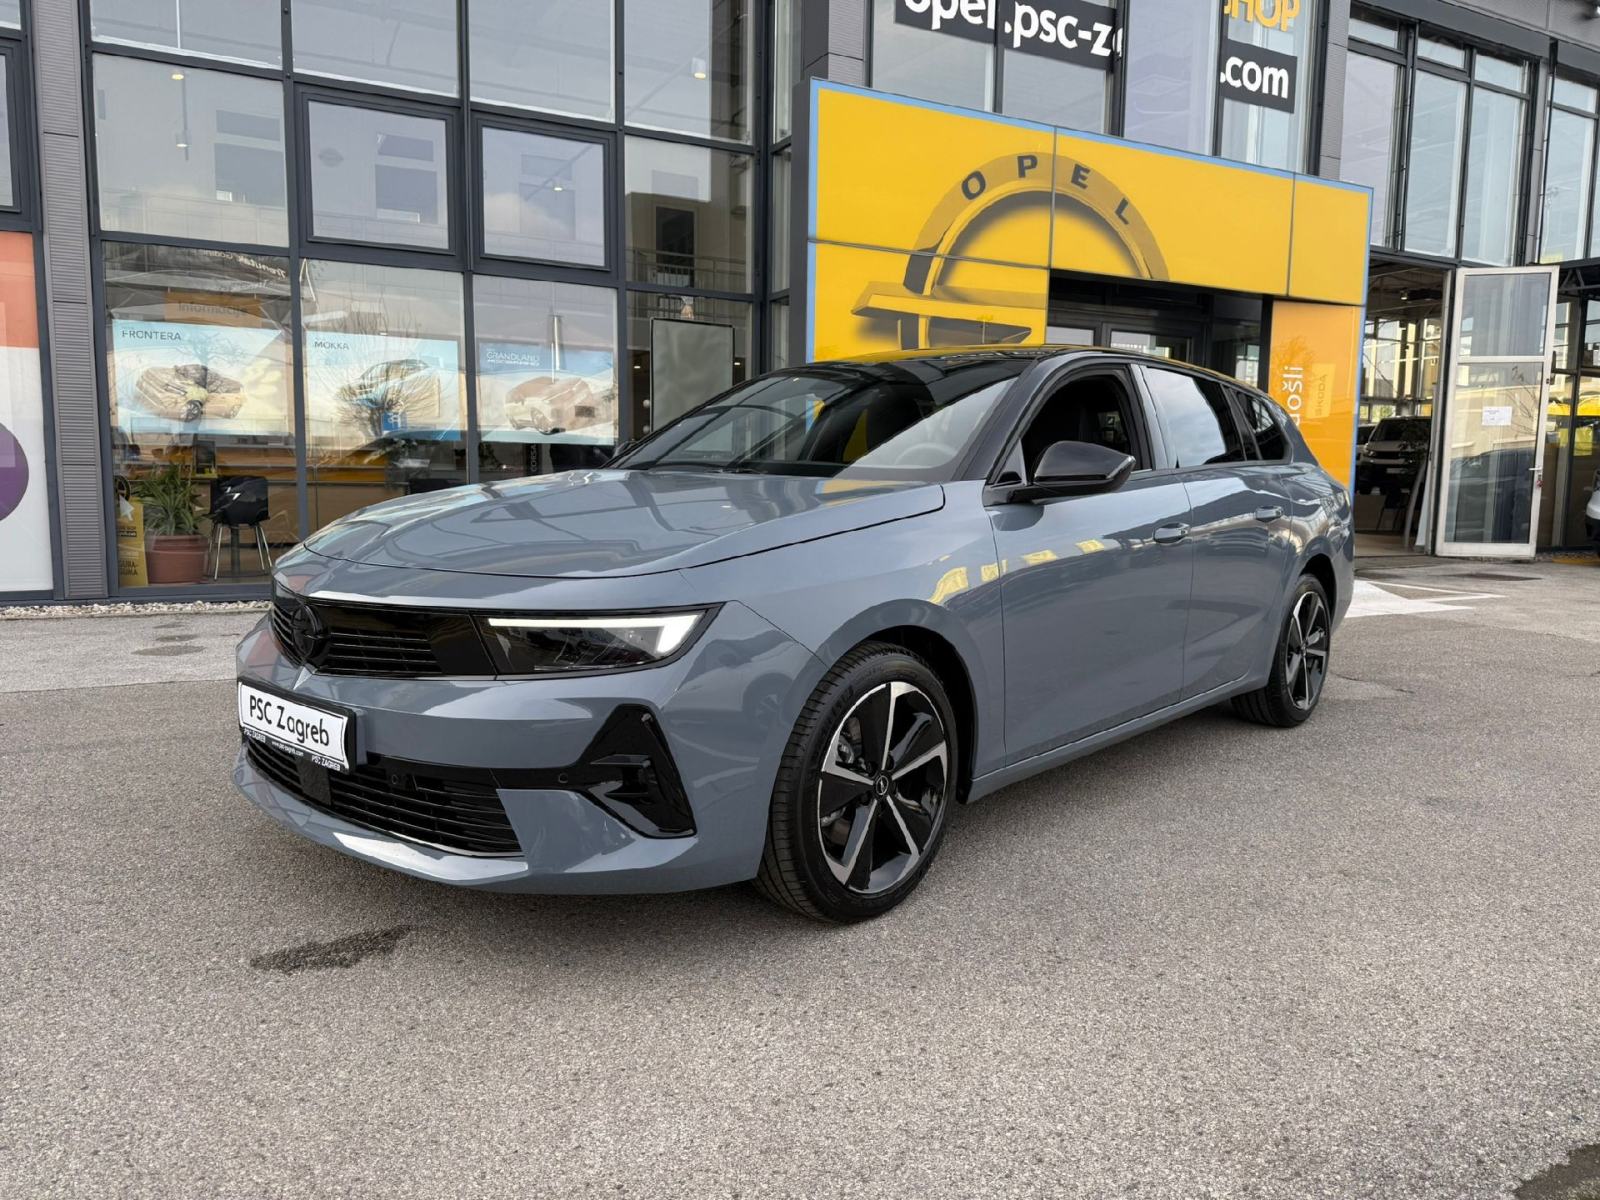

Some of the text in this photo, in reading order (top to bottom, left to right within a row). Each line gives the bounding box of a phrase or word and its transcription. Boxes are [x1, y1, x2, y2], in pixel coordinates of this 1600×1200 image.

[1223, 0, 1301, 32] HOP
[1220, 56, 1289, 99] .com
[961, 154, 1129, 225] OPEL
[122, 330, 182, 341] FRONTERA
[314, 341, 350, 351] MOKKA
[486, 351, 541, 361] GRANDLAND
[249, 695, 329, 746] PSC Zagreb
